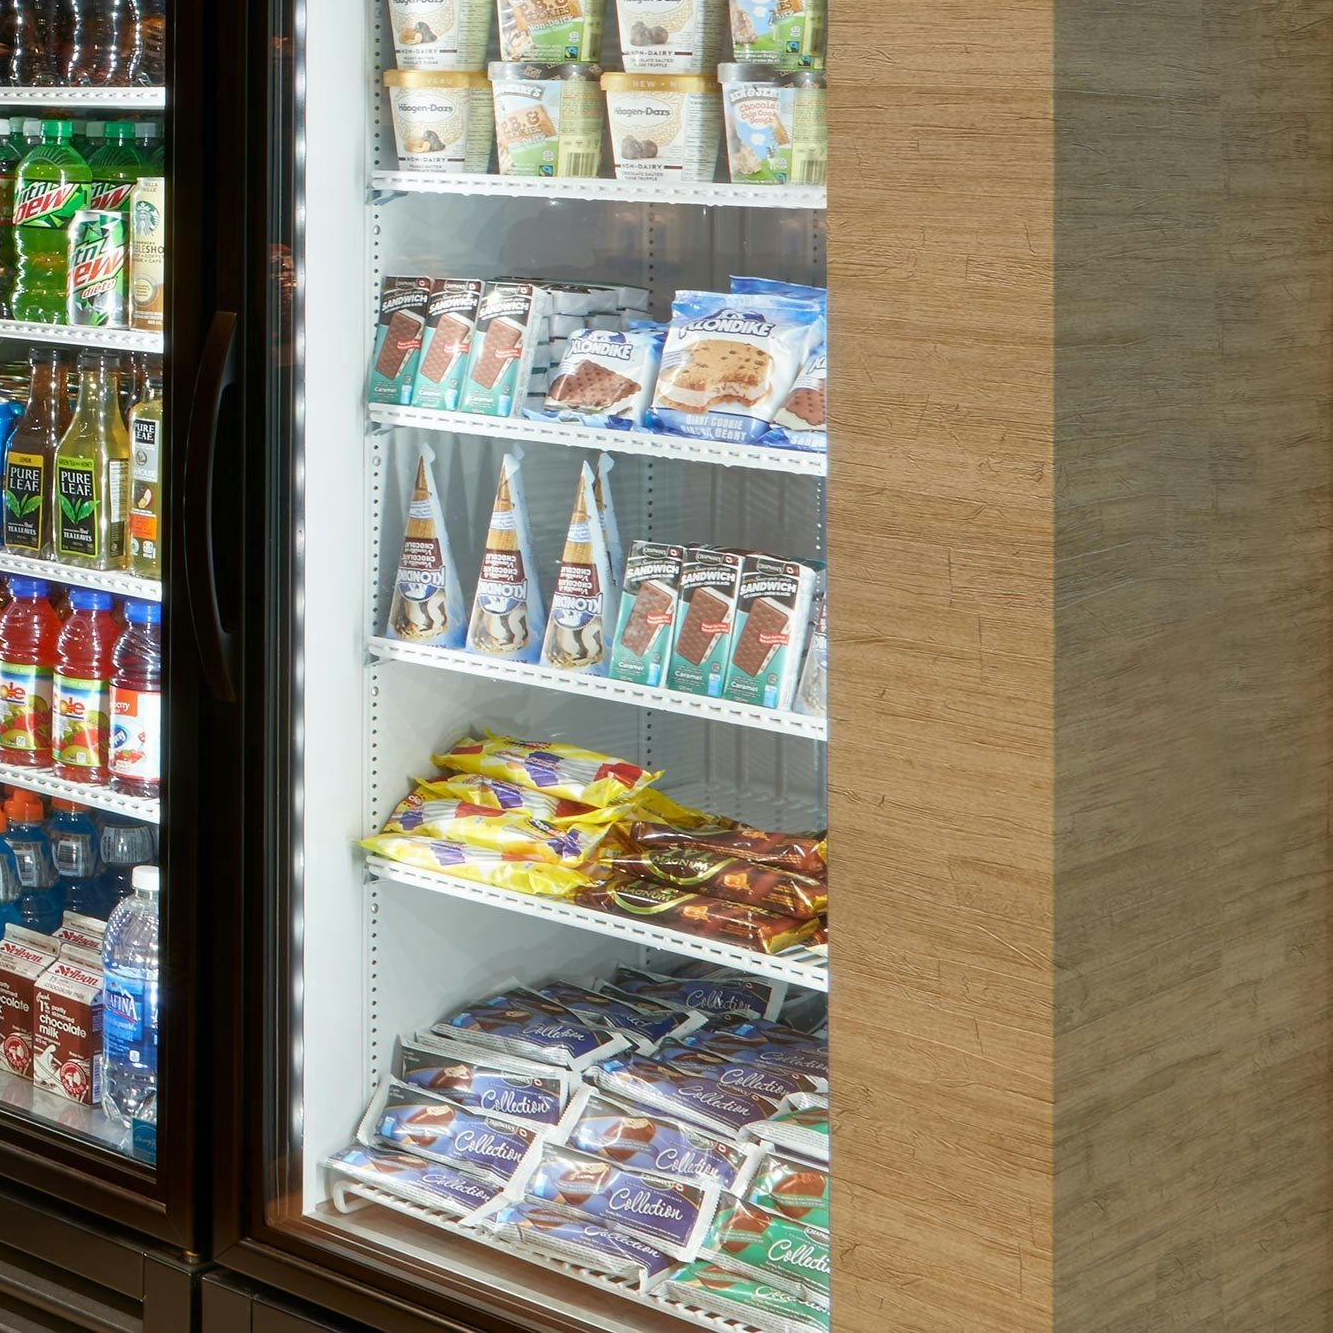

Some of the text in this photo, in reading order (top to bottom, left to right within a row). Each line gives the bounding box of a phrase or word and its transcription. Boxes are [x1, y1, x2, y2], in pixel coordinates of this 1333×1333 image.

[382, 294, 428, 311] SANDWICH
[429, 297, 477, 314] SANDWICH
[679, 318, 775, 338] KLONDIKE
[565, 340, 633, 360] KLONDIKE
[10, 467, 40, 481] PURE
[61, 471, 91, 485] PURE
[626, 564, 679, 580] SANDWICH
[681, 571, 735, 586] SANDWICH
[739, 581, 797, 596] SANDWICH
[618, 661, 645, 671] Caramel
[674, 670, 703, 681] Caramel
[731, 681, 758, 692] Caramel
[652, 854, 714, 872] MAGNUM
[620, 884, 675, 903] MAGNUM
[59, 930, 101, 950] Neilson
[0, 941, 44, 964] Neilson
[54, 965, 98, 987] Neilson
[686, 988, 751, 1013] Collection
[39, 1013, 87, 1038] chocolate
[39, 1024, 59, 1040] milk
[720, 1069, 789, 1098] Collection
[481, 1089, 551, 1115] Collection
[678, 1085, 750, 1117] Collection
[454, 1130, 525, 1163] Collection
[422, 1173, 491, 1203] Collection
[609, 1188, 684, 1221] Collection
[767, 1239, 830, 1274] Collecti
